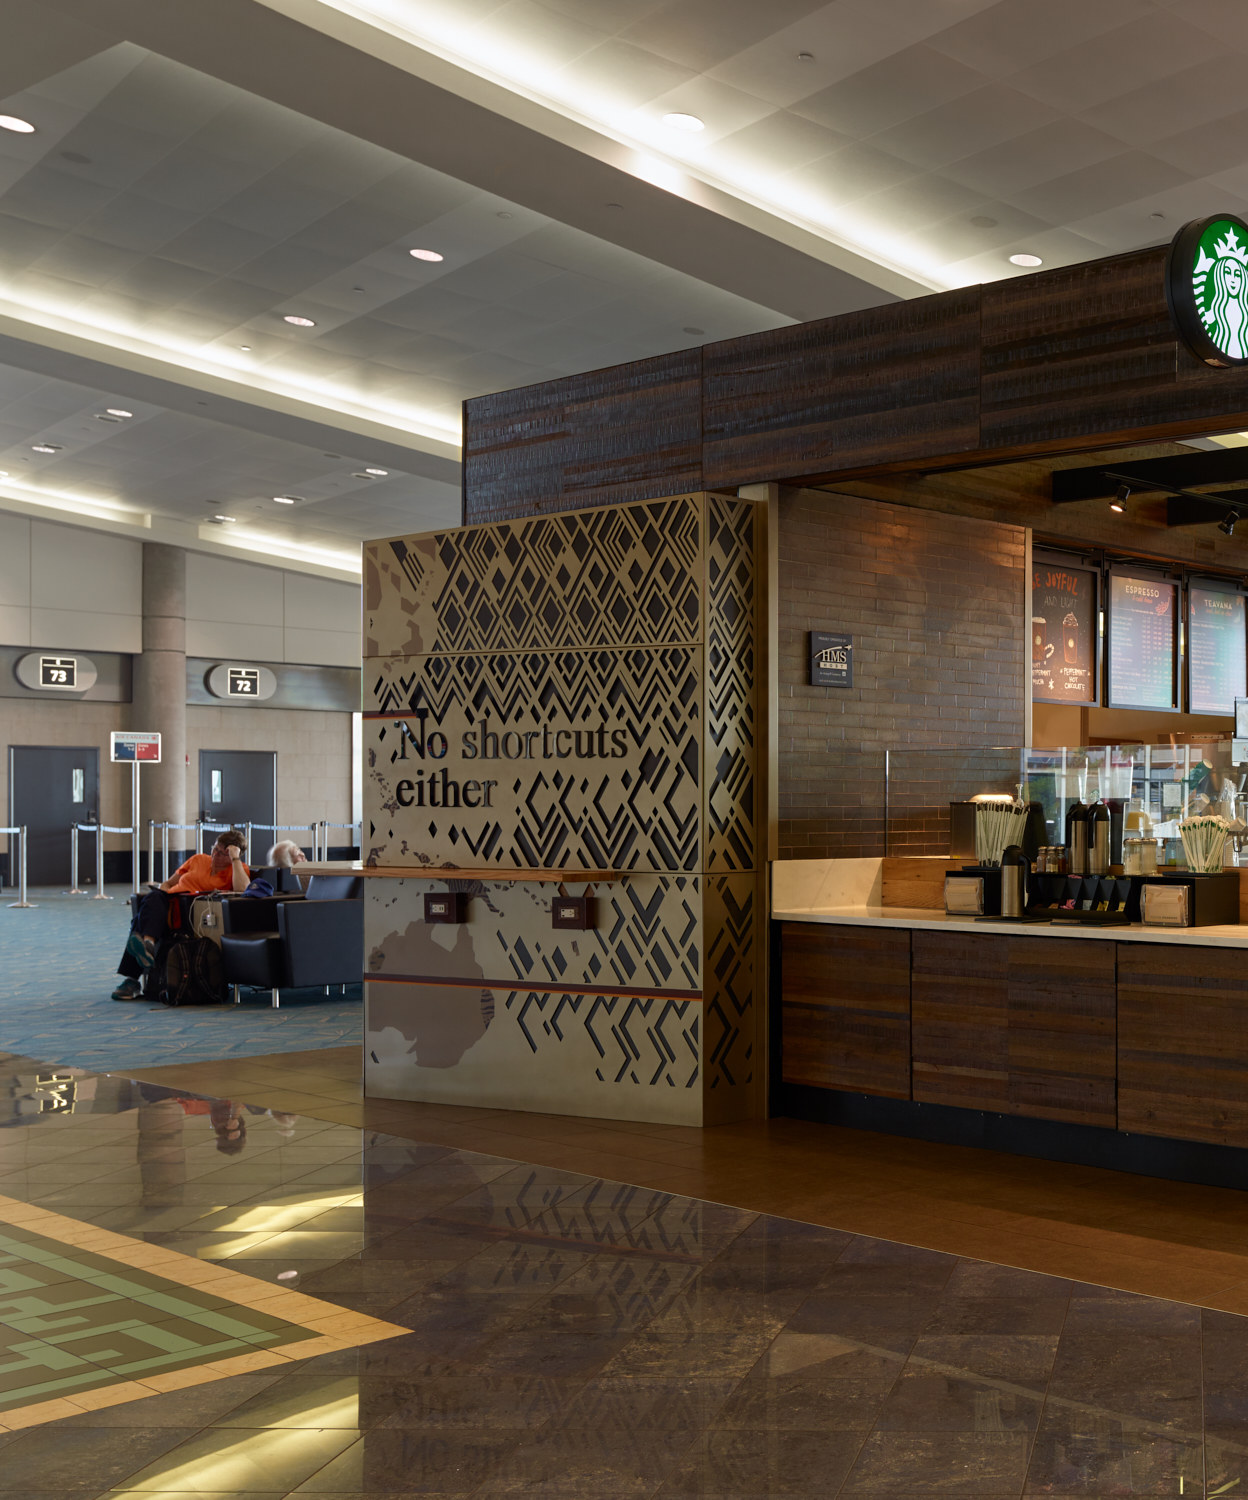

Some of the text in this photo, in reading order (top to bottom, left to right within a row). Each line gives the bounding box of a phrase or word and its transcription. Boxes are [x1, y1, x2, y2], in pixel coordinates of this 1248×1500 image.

[1045, 572, 1078, 595] JOYFUL
[1125, 585, 1160, 598] ESPRESSO
[1204, 599, 1232, 610] TEAVANA
[822, 650, 847, 663] HMS
[50, 669, 67, 682] 73
[236, 679, 251, 692] 72
[394, 708, 628, 760] No shortcuts
[395, 767, 498, 808] either
